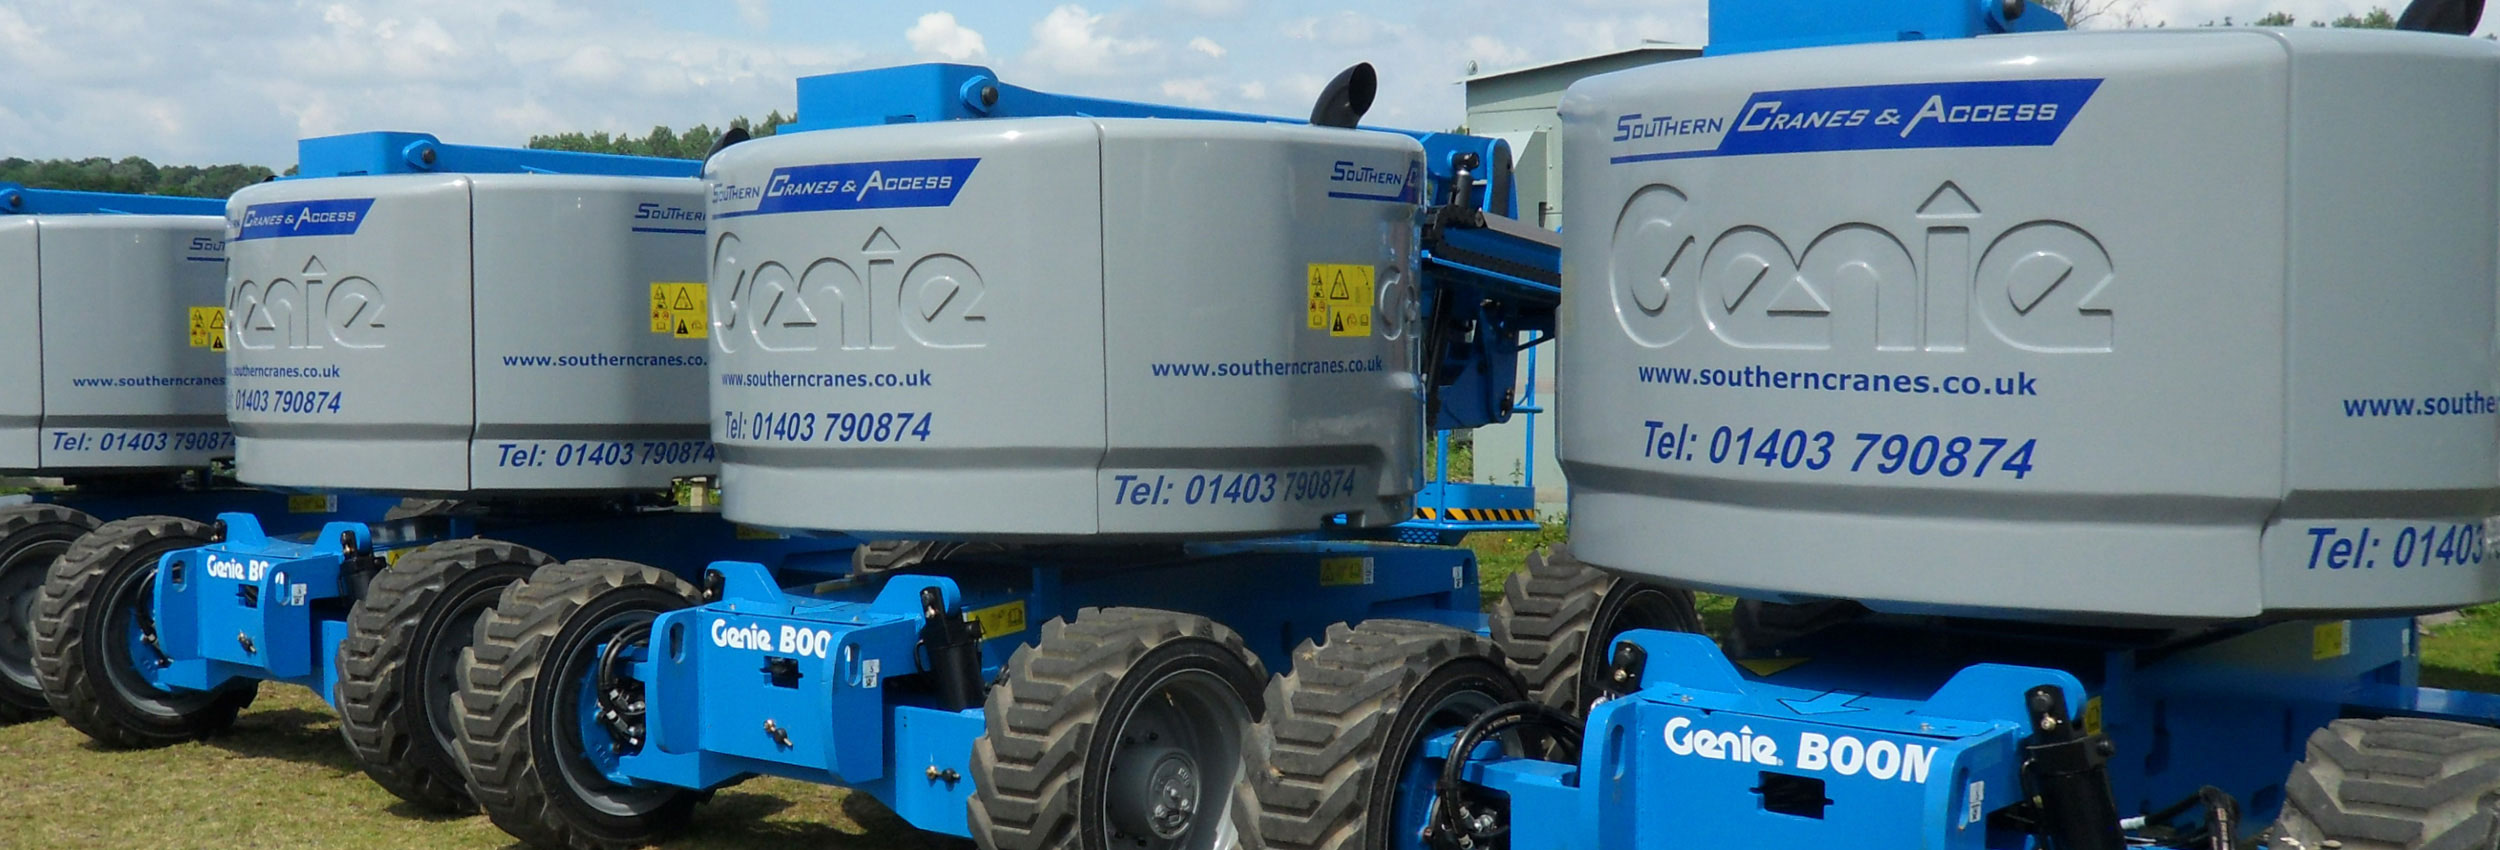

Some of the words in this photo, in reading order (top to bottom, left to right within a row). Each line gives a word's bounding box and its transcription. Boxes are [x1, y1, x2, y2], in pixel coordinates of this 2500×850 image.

[1613, 113, 1723, 142] SOUTHERN
[1738, 101, 1869, 134] CRANES
[1874, 109, 1900, 126] &
[1901, 95, 2058, 138] ACCESS
[712, 183, 760, 203] SOUTHERN
[767, 174, 838, 197] CRANES
[841, 180, 857, 193] &
[856, 170, 952, 202] ACCESS
[1331, 161, 1402, 184] SOUTHERN
[243, 211, 281, 227] CRANES
[284, 214, 294, 224] &
[294, 207, 356, 231] ACCESS
[1609, 180, 2114, 354] Genie
[712, 226, 986, 353] Genie
[721, 369, 932, 387] www.southerncranes.co.uk
[1151, 355, 1382, 376] www.southerncranes.co.uk
[1638, 365, 2037, 396] www.southerncranes.co.uk
[235, 389, 269, 412] 01403
[273, 391, 342, 413] 790874
[2343, 390, 2500, 417] www.southe
[53, 432, 92, 450] Tel:
[99, 432, 167, 451] 01403
[725, 411, 747, 440] Tel:
[752, 411, 816, 441] 01403
[824, 412, 932, 442] 790874
[498, 444, 546, 467] Tel:
[555, 443, 634, 466] 01403
[641, 441, 716, 465] 790874
[1644, 420, 1697, 461] Tel:
[1709, 426, 1835, 472] 01403
[1850, 433, 2037, 479] 790874
[1113, 475, 1173, 505] Tel:
[1185, 473, 1277, 504] 01403
[1283, 468, 1356, 501] 790874
[2308, 527, 2380, 569] Tel:
[207, 554, 245, 580] Genie
[711, 618, 771, 651] Genie
[779, 625, 832, 659] BOO
[1664, 716, 1778, 765] Genie
